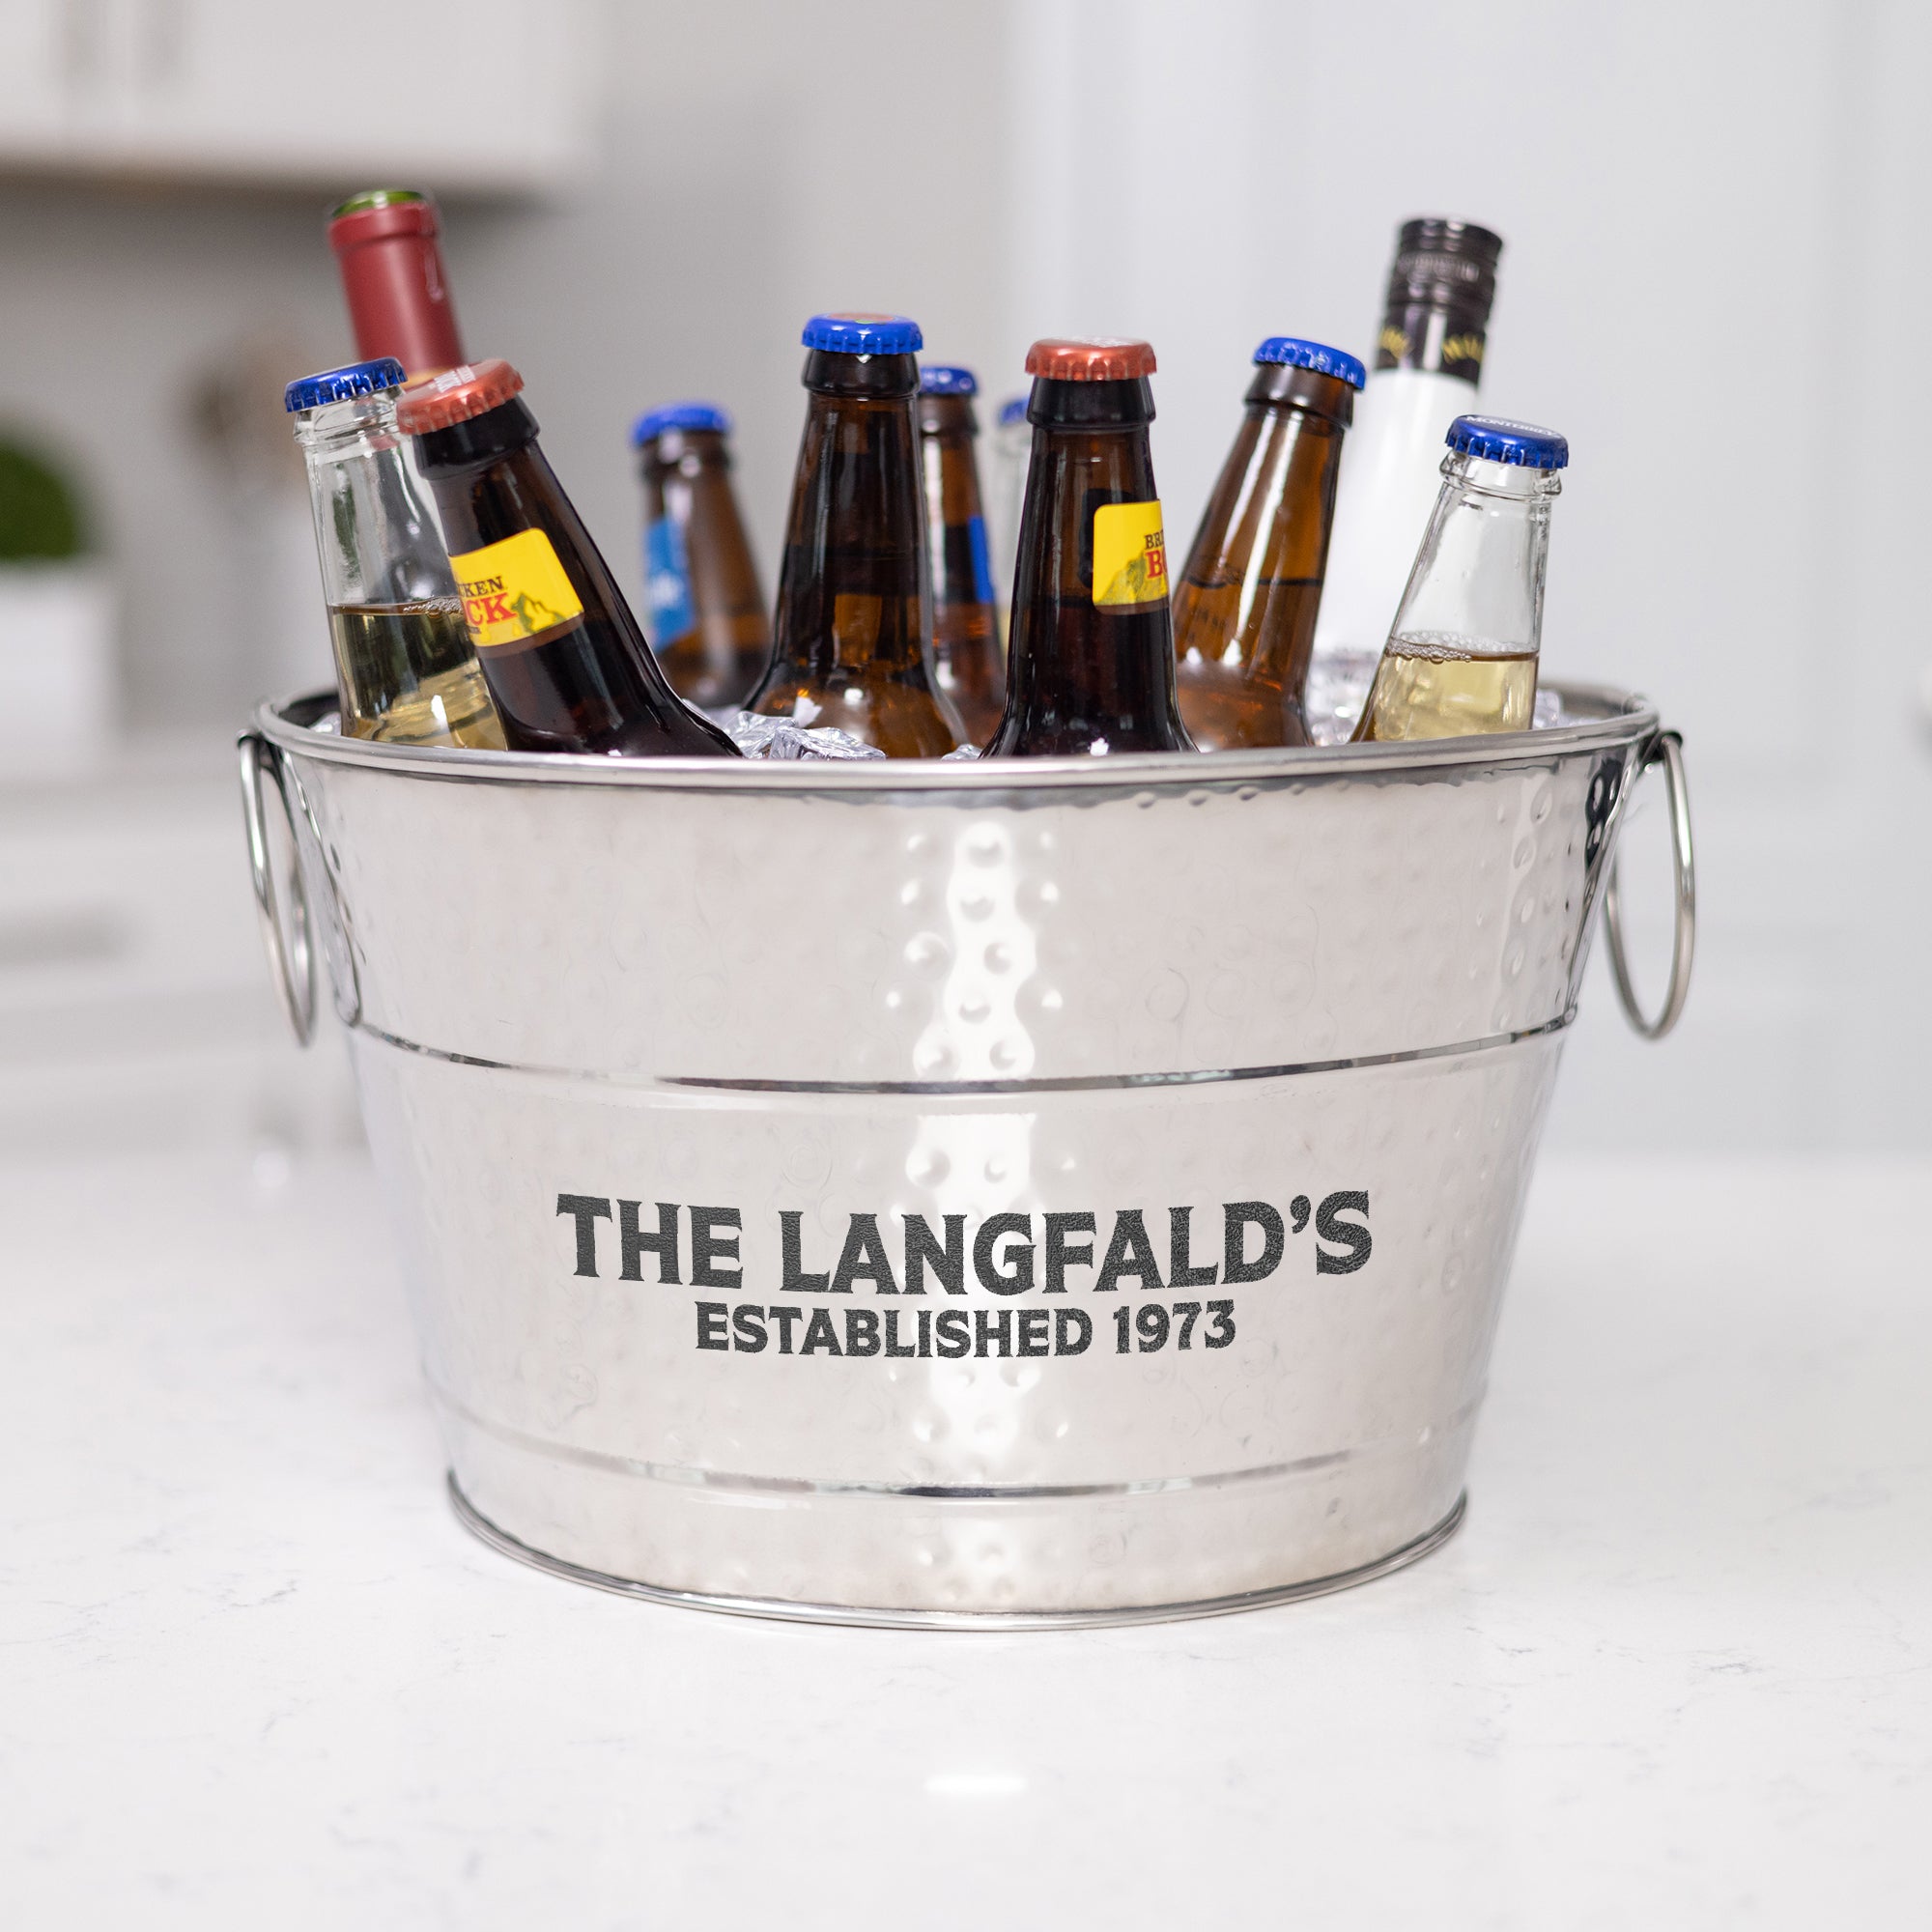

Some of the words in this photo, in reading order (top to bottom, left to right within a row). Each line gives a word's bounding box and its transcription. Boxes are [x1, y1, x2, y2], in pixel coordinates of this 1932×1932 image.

[556, 1194, 744, 1290] THE
[779, 1190, 1373, 1296] LANGFALD'S
[696, 1301, 1094, 1359] ESTABLISHED
[1112, 1299, 1236, 1354] 1973
